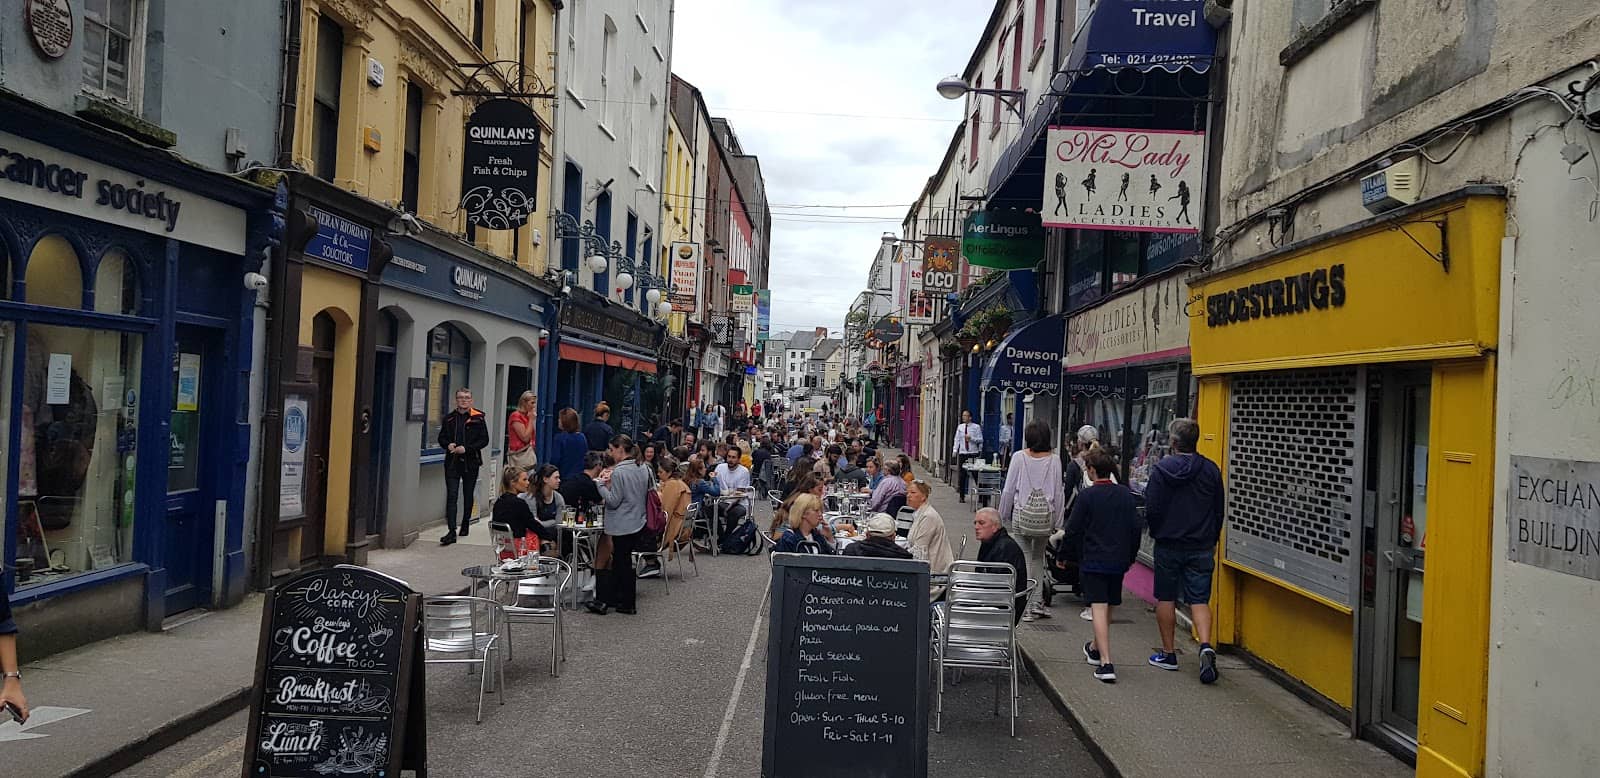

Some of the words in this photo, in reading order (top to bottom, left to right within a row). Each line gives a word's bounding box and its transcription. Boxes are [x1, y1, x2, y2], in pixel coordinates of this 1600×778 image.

[1132, 9, 1196, 27] Travel
[1101, 54, 1120, 64] Tel:
[1128, 55, 1146, 64] 021
[470, 126, 535, 140] QUINLAN'S
[489, 156, 512, 166] Fresh
[473, 166, 491, 175] Fish
[492, 167, 499, 176] &
[501, 167, 528, 178] Chips
[96, 179, 181, 232] society
[1079, 203, 1166, 219] LADIES
[1071, 216, 1171, 227] ACCESSORIES
[340, 219, 369, 240] RIORDAN
[968, 223, 990, 233] Aer
[990, 223, 1028, 237] Lingus
[332, 233, 339, 245] &
[322, 244, 354, 265] SOLICITORS
[455, 266, 487, 293] QUINLAN'S
[1207, 263, 1346, 328] SHOESTRINGS
[1102, 302, 1137, 334] LADIES
[1006, 346, 1058, 360] Dawson
[1011, 362, 1050, 376] Travel
[1016, 380, 1028, 388] 021
[342, 573, 354, 587] &
[867, 576, 909, 590] Rossini
[805, 594, 818, 604] On
[847, 597, 864, 605] and
[869, 595, 879, 605] in
[805, 606, 833, 620] Dining
[802, 621, 853, 633] Homemade
[883, 624, 899, 633] and
[292, 627, 360, 664] Coffee
[800, 650, 824, 666] Aged
[798, 669, 829, 682] Fresh
[833, 671, 855, 683] Fish
[276, 675, 358, 704] Breakfast
[827, 689, 849, 704] free
[853, 693, 879, 702] menu
[822, 712, 844, 722] Sun
[262, 720, 322, 752] Lunch
